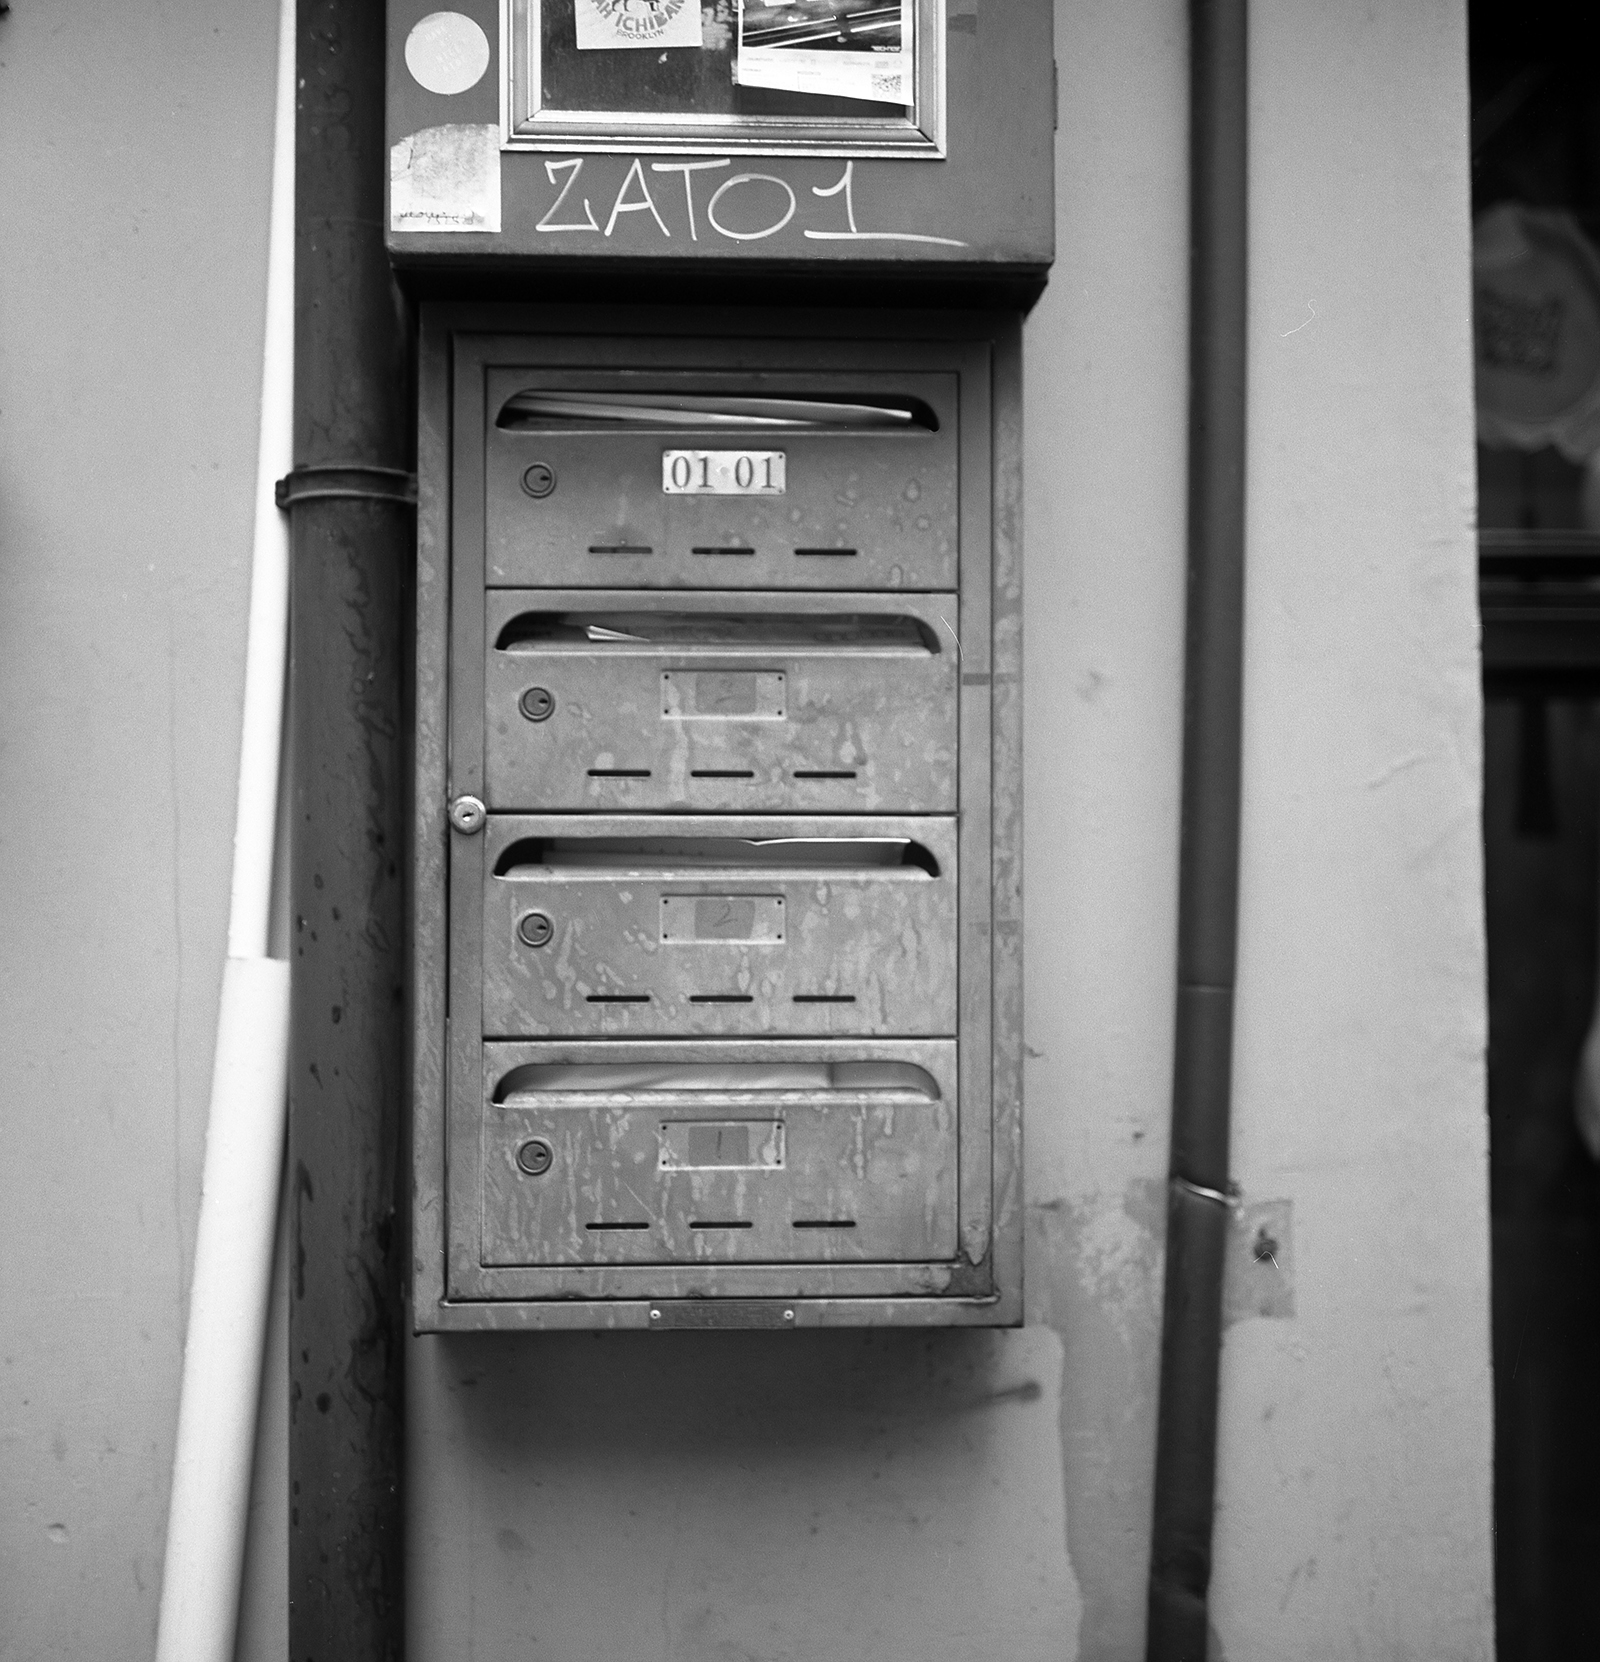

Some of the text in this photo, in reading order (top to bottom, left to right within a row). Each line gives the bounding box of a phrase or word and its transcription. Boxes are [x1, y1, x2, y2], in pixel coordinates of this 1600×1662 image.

[616, 29, 665, 40] BROOKLYN
[671, 455, 776, 489] 01 01
[713, 902, 738, 928] 2
